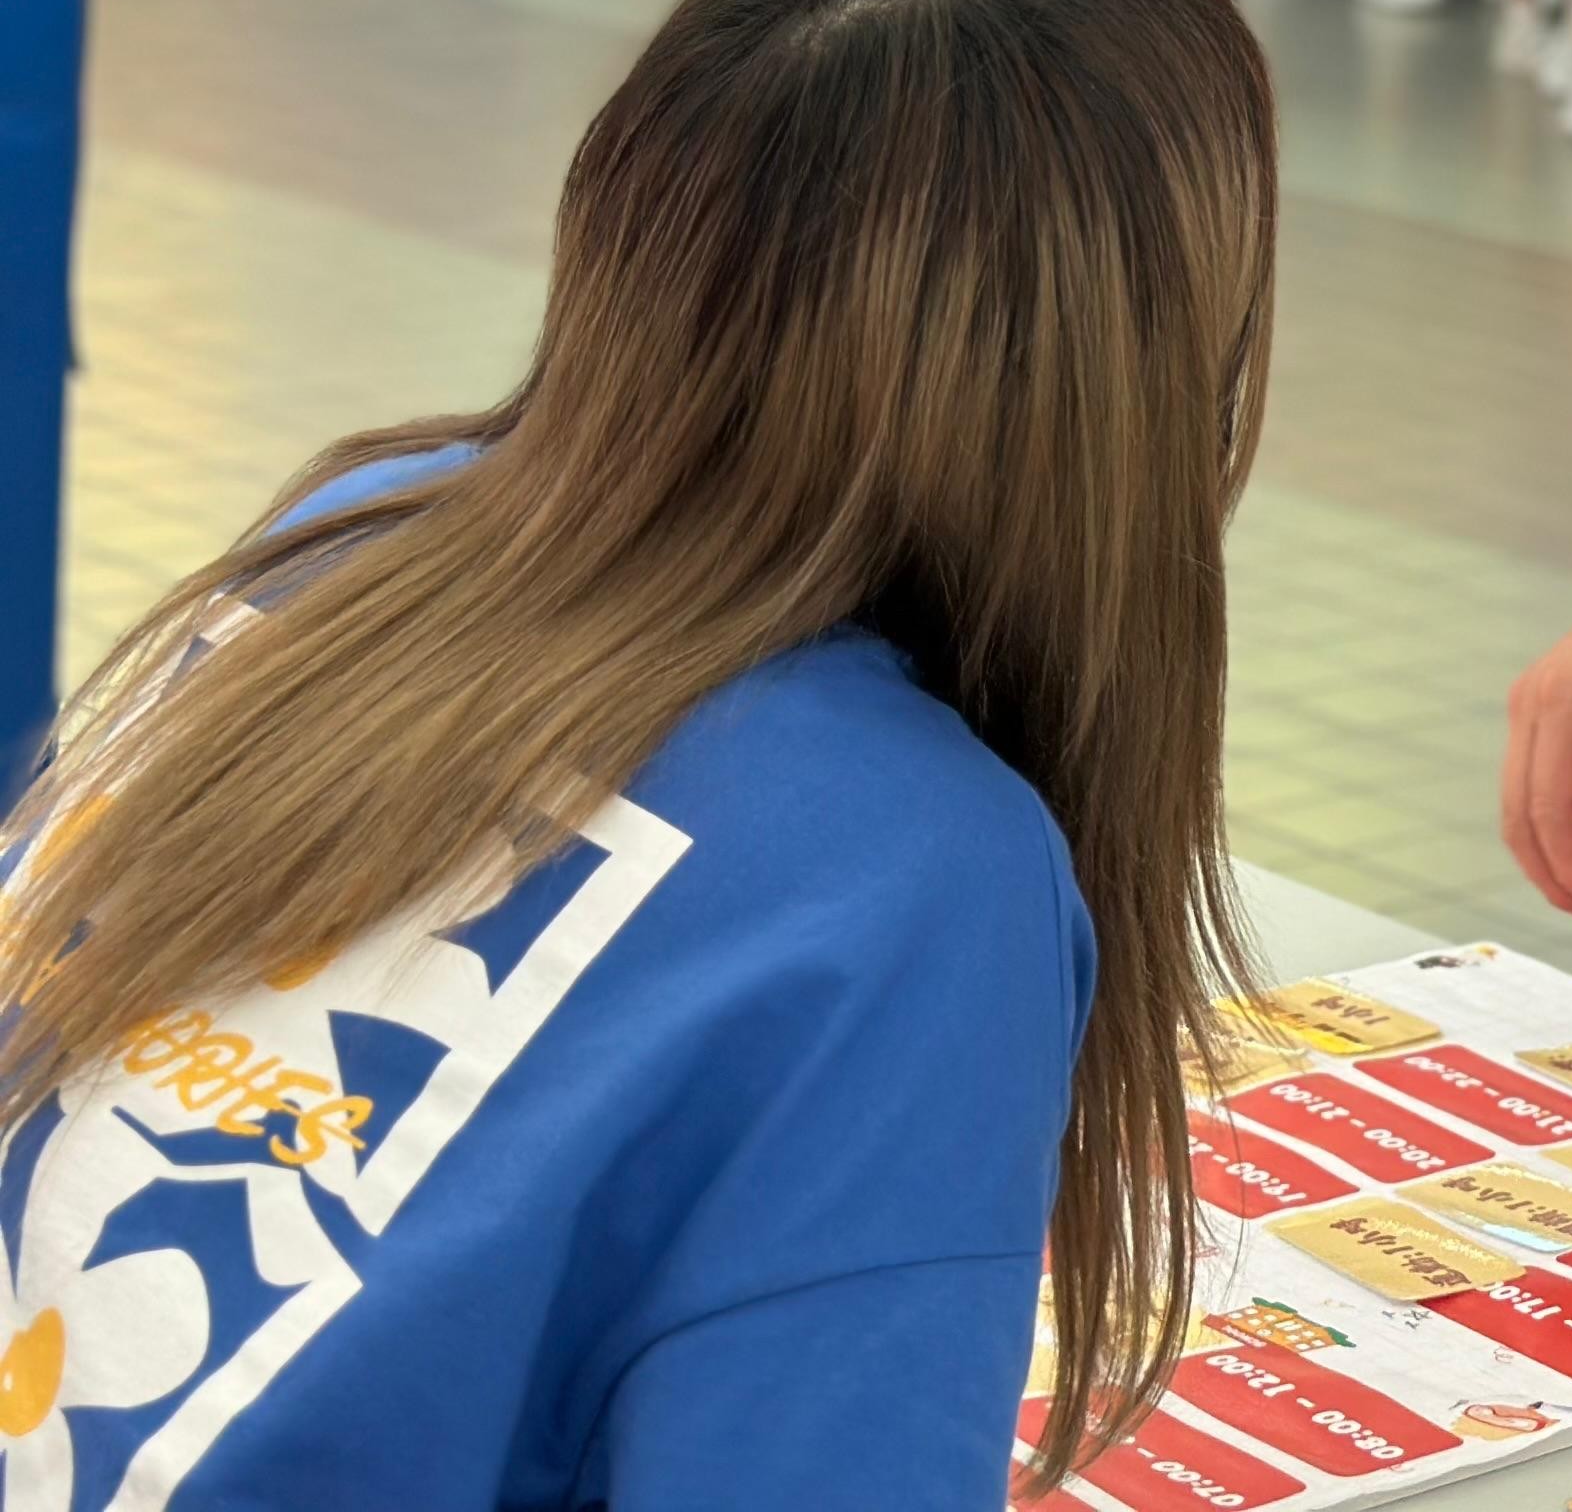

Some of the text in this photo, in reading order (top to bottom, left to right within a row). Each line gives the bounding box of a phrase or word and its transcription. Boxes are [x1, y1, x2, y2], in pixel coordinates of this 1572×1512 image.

[1403, 1056, 1484, 1089] 22:00
[1269, 1083, 1350, 1120] 21:00
[1363, 1127, 1447, 1170] 20:00
[1226, 1161, 1307, 1203] 19:00
[1205, 1354, 1296, 1398] 12:00
[1312, 1410, 1404, 1460] 08:00
[1151, 1460, 1246, 1508] 07:00
